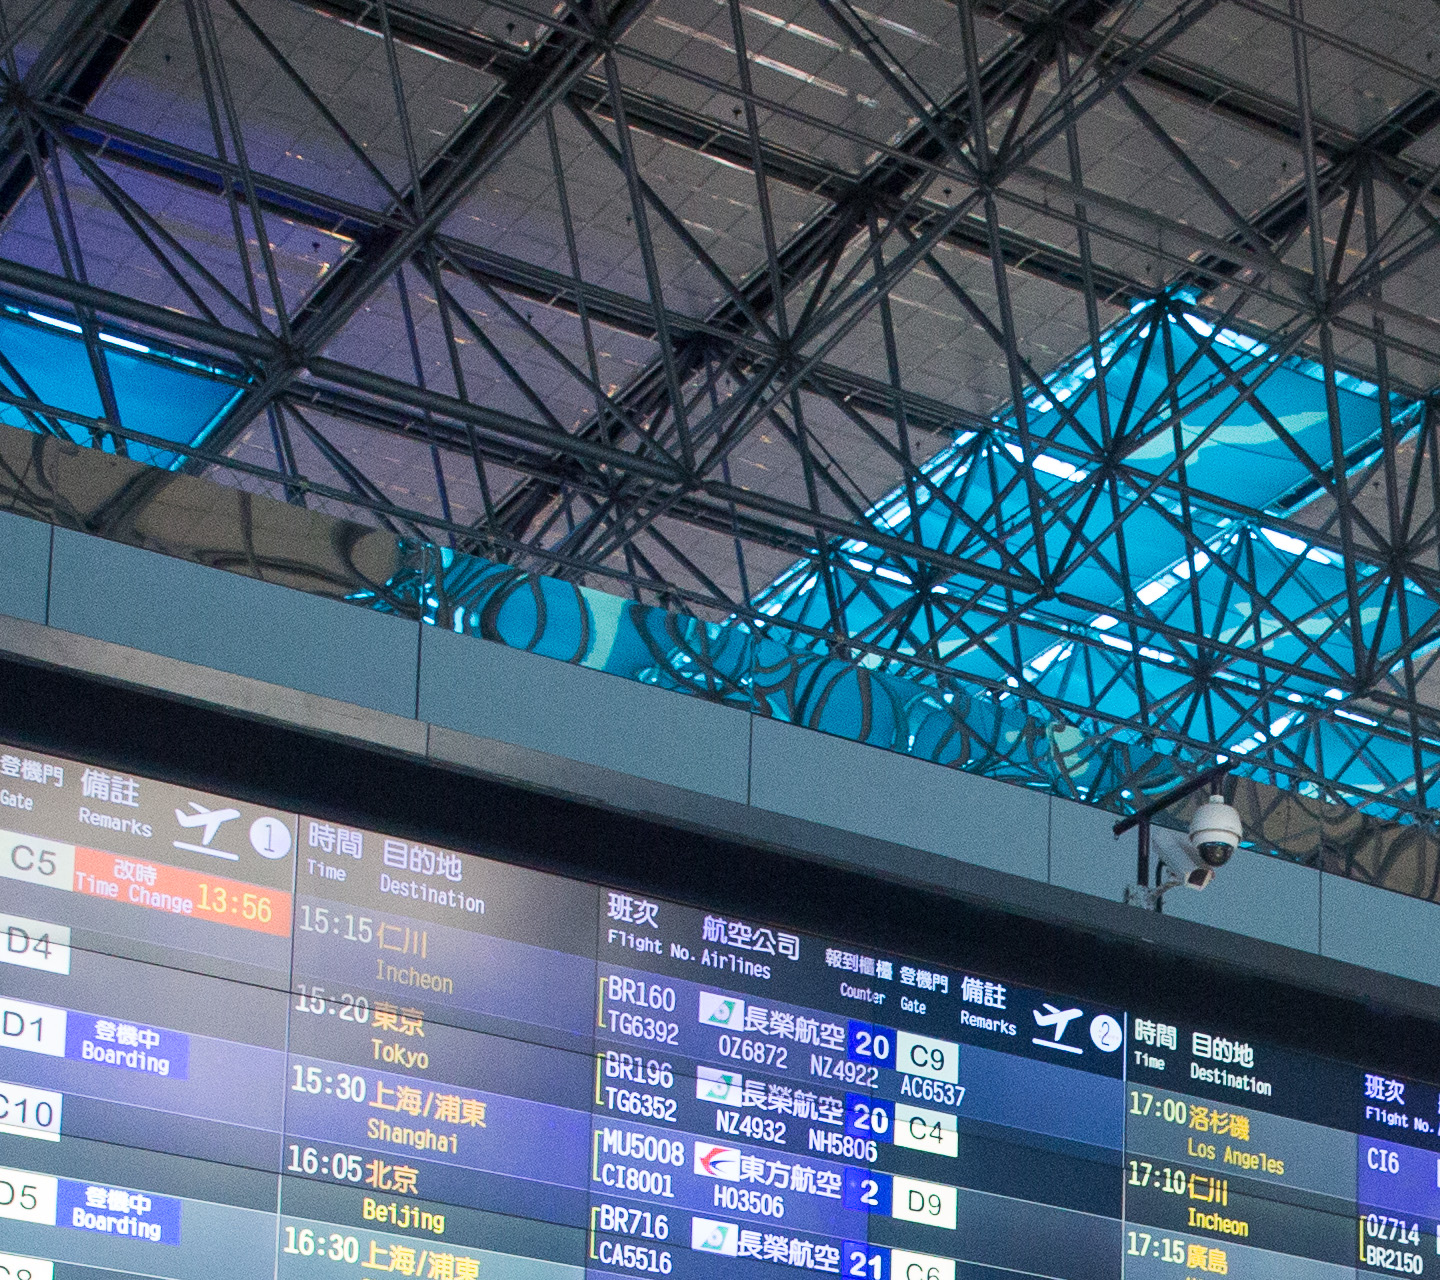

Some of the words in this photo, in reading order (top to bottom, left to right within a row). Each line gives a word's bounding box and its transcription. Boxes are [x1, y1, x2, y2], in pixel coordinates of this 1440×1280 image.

[10, 841, 56, 876] C5
[76, 871, 120, 900] Time
[129, 881, 193, 917] Change
[114, 858, 157, 884] 改時
[196, 882, 273, 923] 13:56
[299, 904, 374, 945] 15:15
[376, 920, 429, 958] 仁川
[375, 959, 453, 995] Incheon
[1, 1009, 46, 1044] D1
[94, 1019, 160, 1050] 登機中
[295, 984, 369, 1024] 15:20
[371, 1001, 425, 1038] 東京
[607, 974, 676, 1012] BR160
[745, 1005, 845, 1051] 長榮航空
[856, 1031, 889, 1059] 20
[910, 1044, 945, 1072] C9
[607, 1010, 679, 1047] TG6392
[81, 1042, 170, 1077] Boarding
[371, 1038, 429, 1070] Tokyo
[1129, 1091, 1187, 1125] 17:00
[1188, 1104, 1250, 1142] 洛杉磯
[287, 1146, 363, 1183] 16:05
[365, 1159, 419, 1194] 北京
[1187, 1136, 1216, 1159] Los
[1224, 1143, 1285, 1176] Angeles
[1366, 1147, 1400, 1175] CI6
[362, 1198, 446, 1234] Beijing
